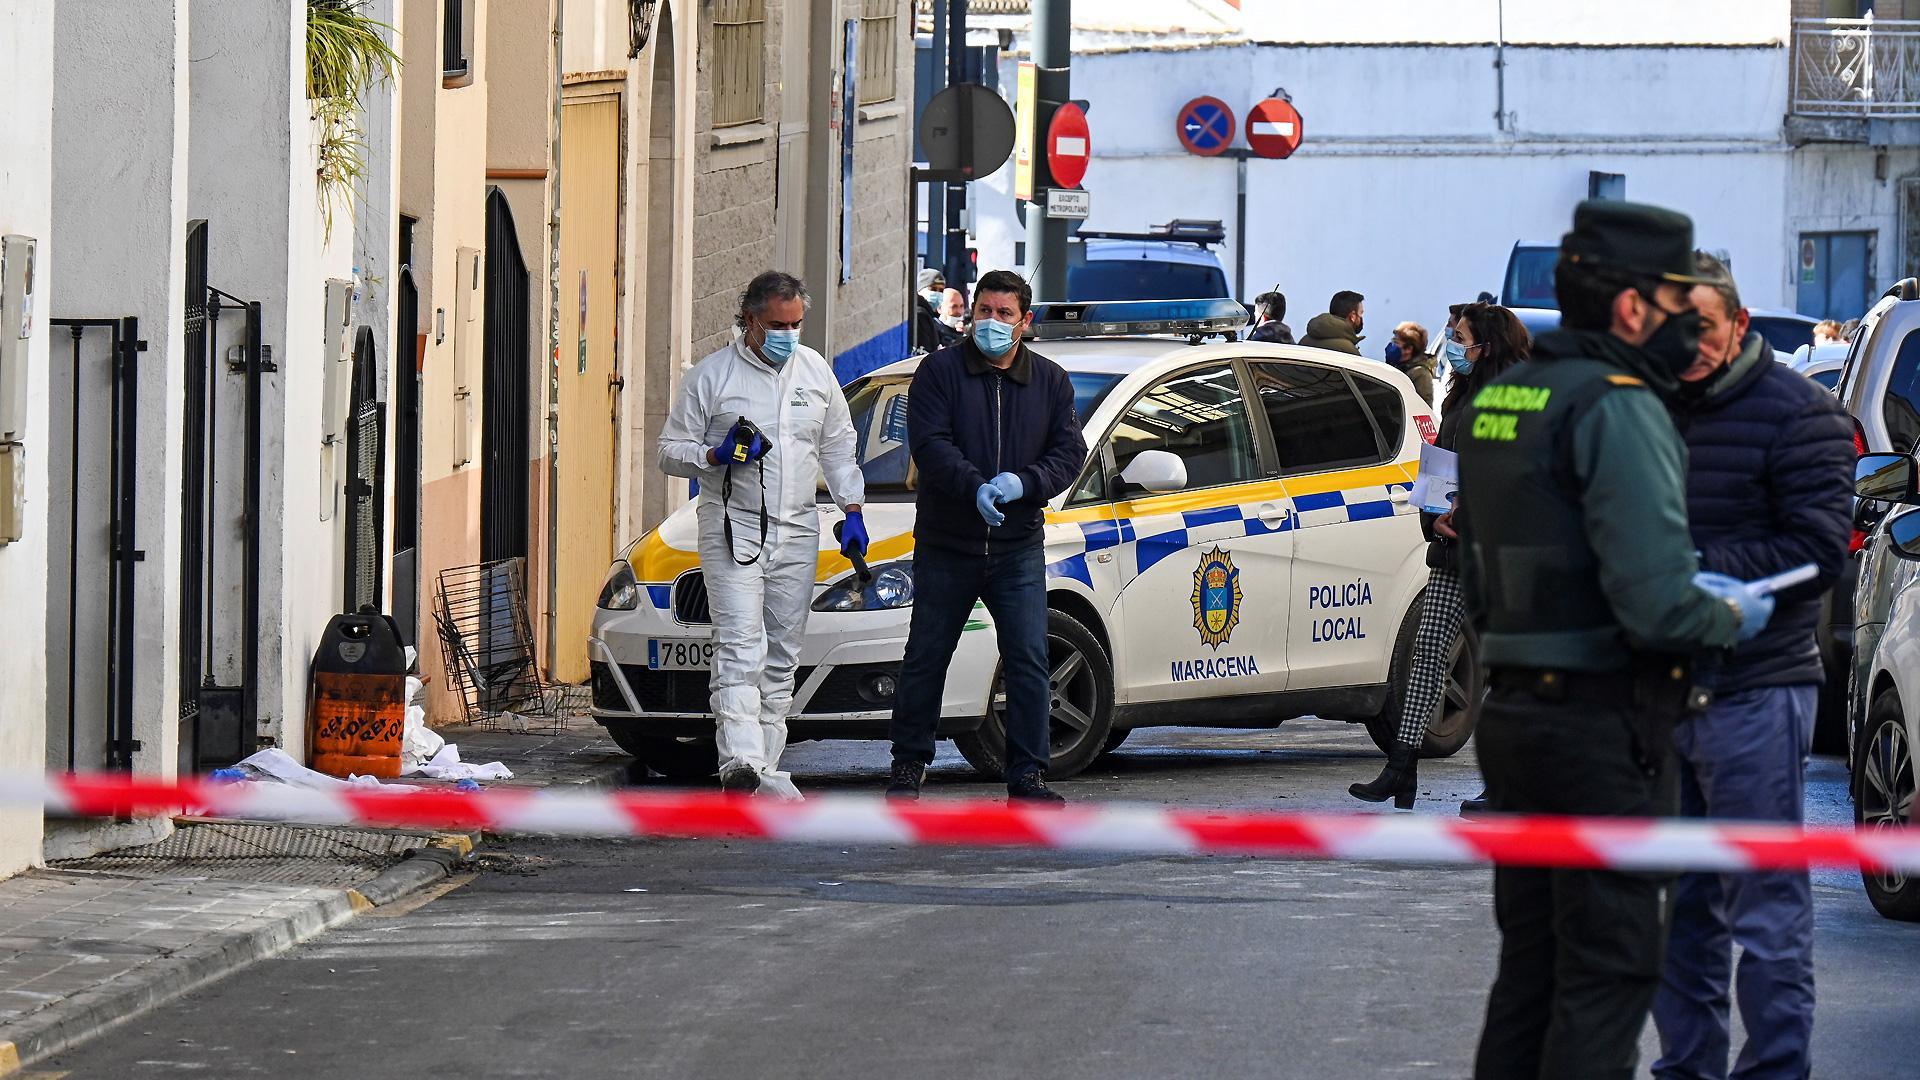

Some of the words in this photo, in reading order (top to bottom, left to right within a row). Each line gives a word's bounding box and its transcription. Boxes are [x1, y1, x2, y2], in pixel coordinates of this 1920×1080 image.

[1472, 384, 1552, 412] GUARDIA
[1472, 412, 1519, 441] CIVIL
[1309, 577, 1373, 610] POLICÍA
[1312, 616, 1366, 643] LOCAL
[661, 642, 714, 667] 7809
[1171, 655, 1260, 682] MARACENA
